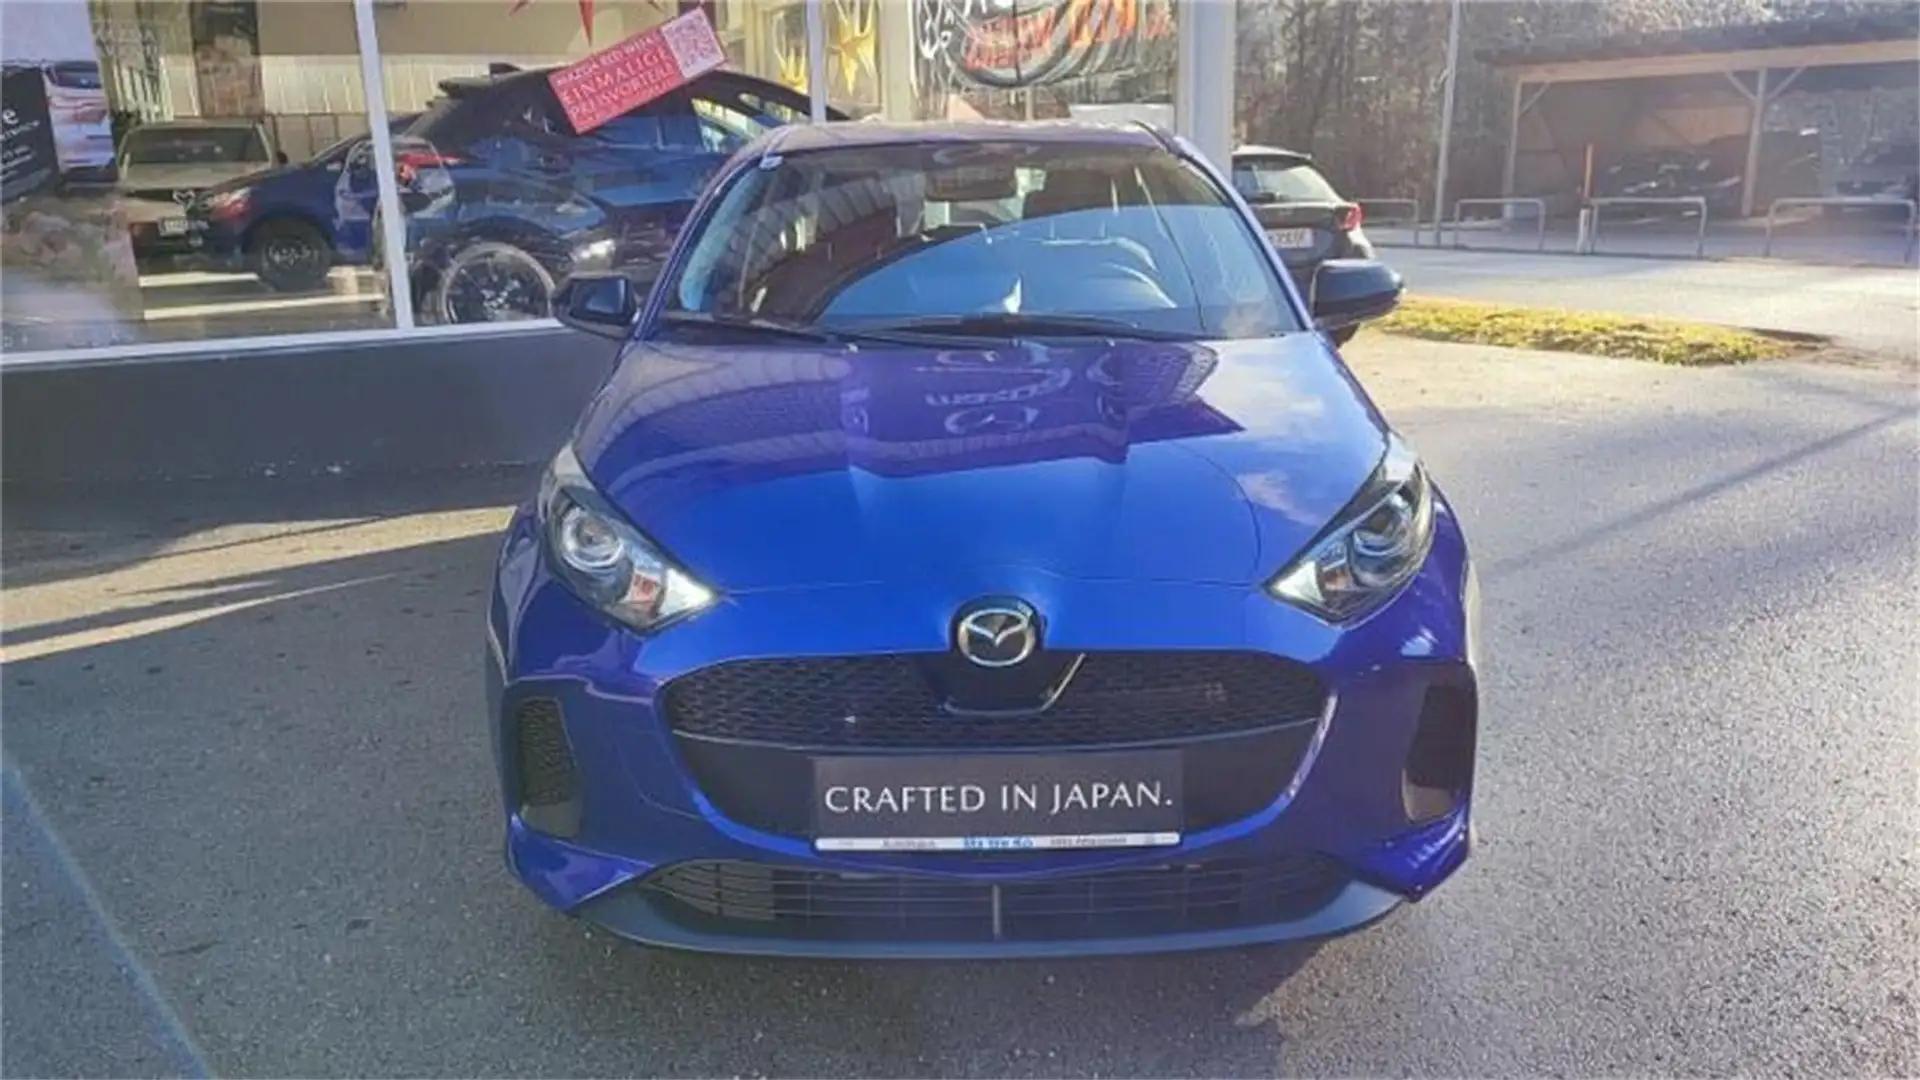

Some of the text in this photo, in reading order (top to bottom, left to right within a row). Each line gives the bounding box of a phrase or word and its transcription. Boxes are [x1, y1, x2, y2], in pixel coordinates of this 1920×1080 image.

[562, 50, 676, 105] EINMALIGE
[824, 781, 1173, 815] CRAFTED IN JAPAN.
